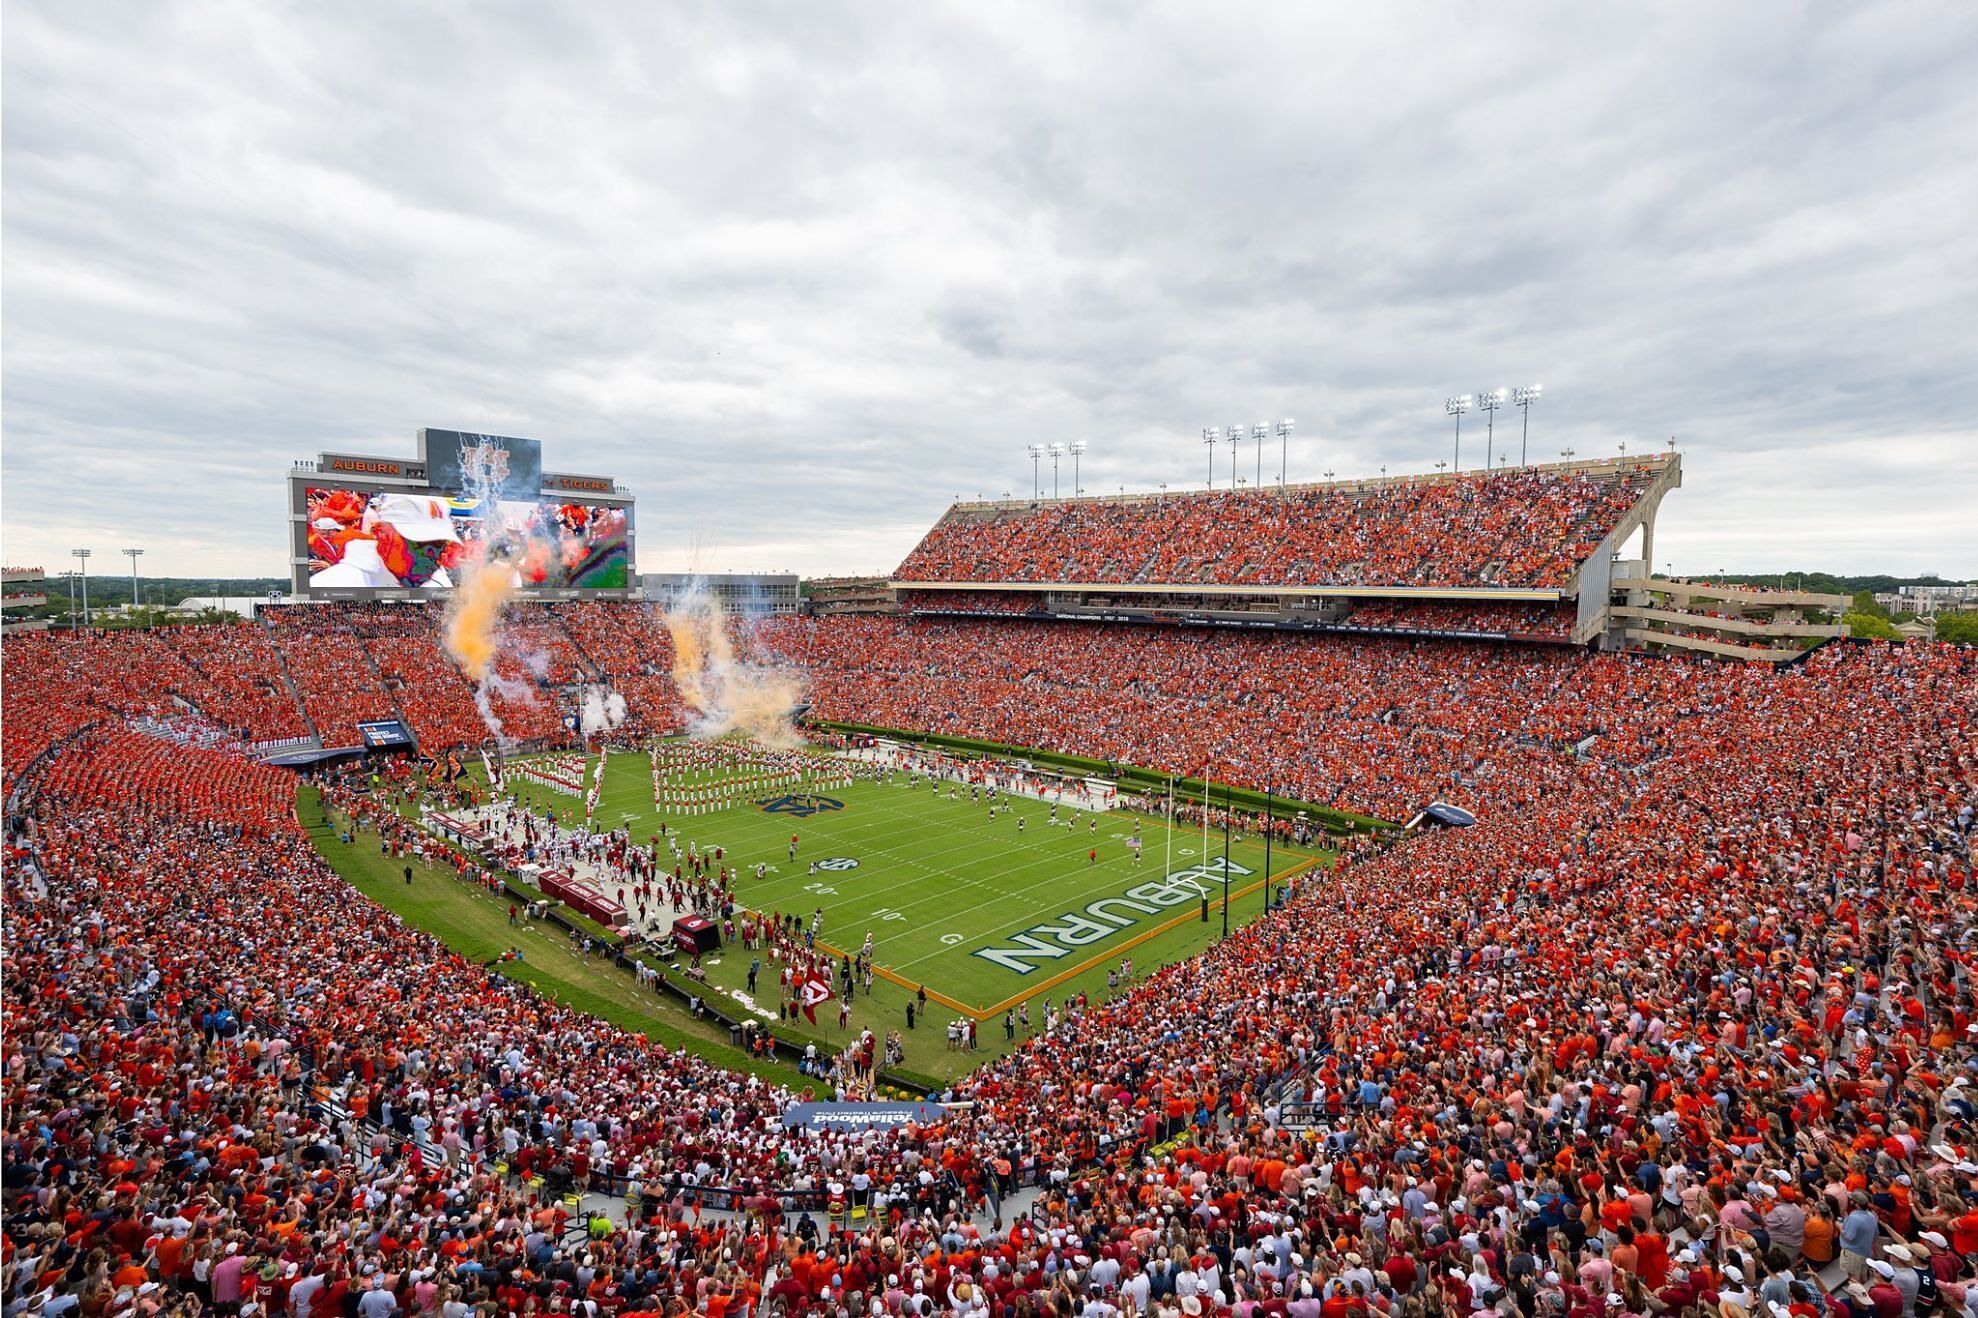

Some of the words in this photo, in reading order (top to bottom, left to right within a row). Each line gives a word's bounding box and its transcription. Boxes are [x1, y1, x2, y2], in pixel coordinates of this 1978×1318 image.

[332, 458, 399, 475] AUBURN
[561, 479, 608, 492] TIGERS
[802, 882, 835, 895] 20
[871, 908, 902, 921] 10
[969, 855, 1257, 975] AUBURN
[940, 933, 964, 945] G
[1922, 1275, 1930, 1286] 2
